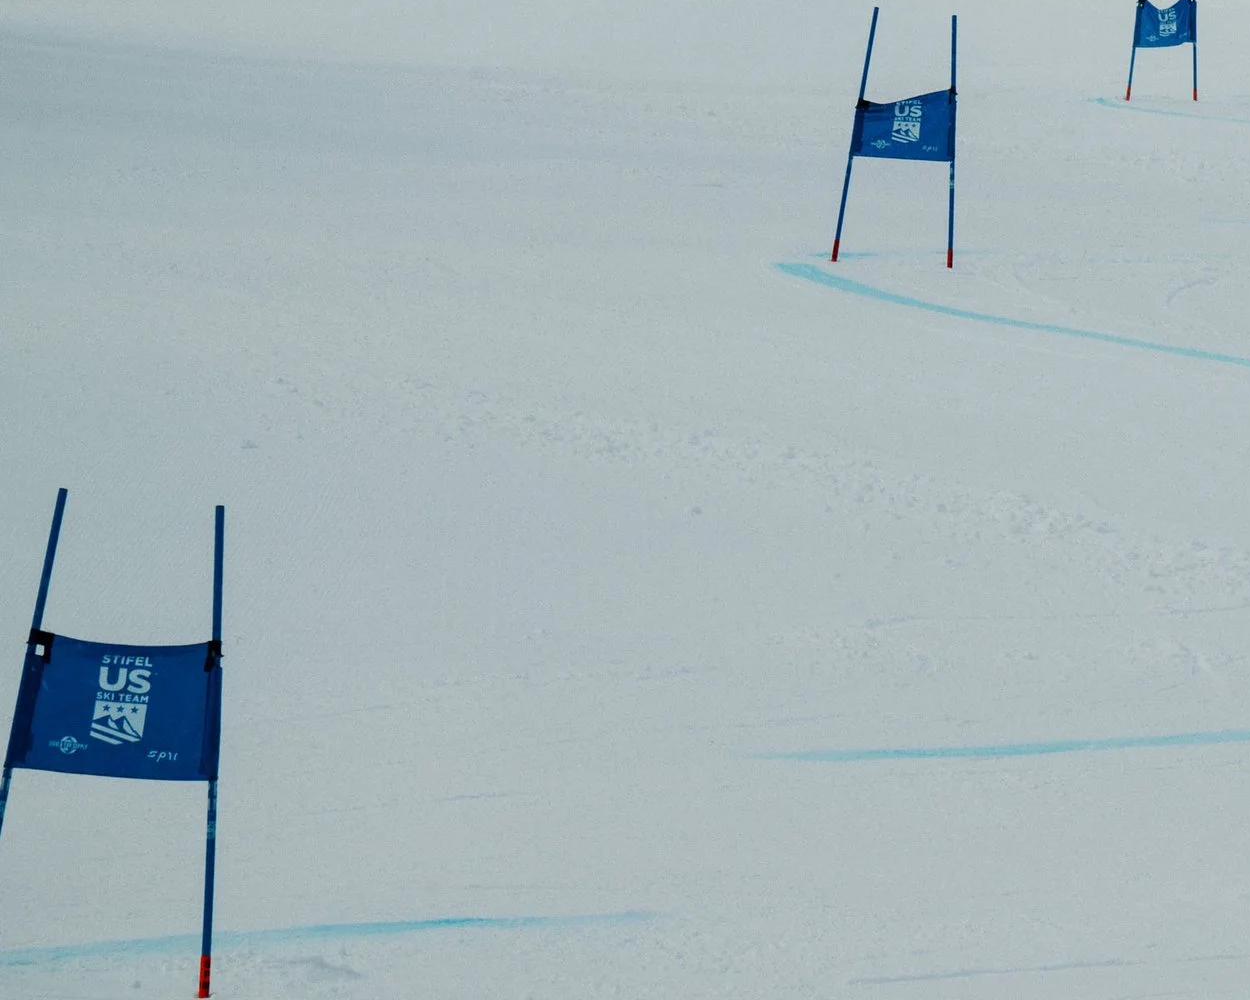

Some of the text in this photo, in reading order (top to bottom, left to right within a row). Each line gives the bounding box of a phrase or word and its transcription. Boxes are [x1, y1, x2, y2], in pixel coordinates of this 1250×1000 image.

[1158, 11, 1176, 21] US
[894, 105, 922, 117] US
[102, 654, 152, 667] STIFEL
[99, 666, 151, 694] US
[96, 691, 149, 704] SKI TEAM
